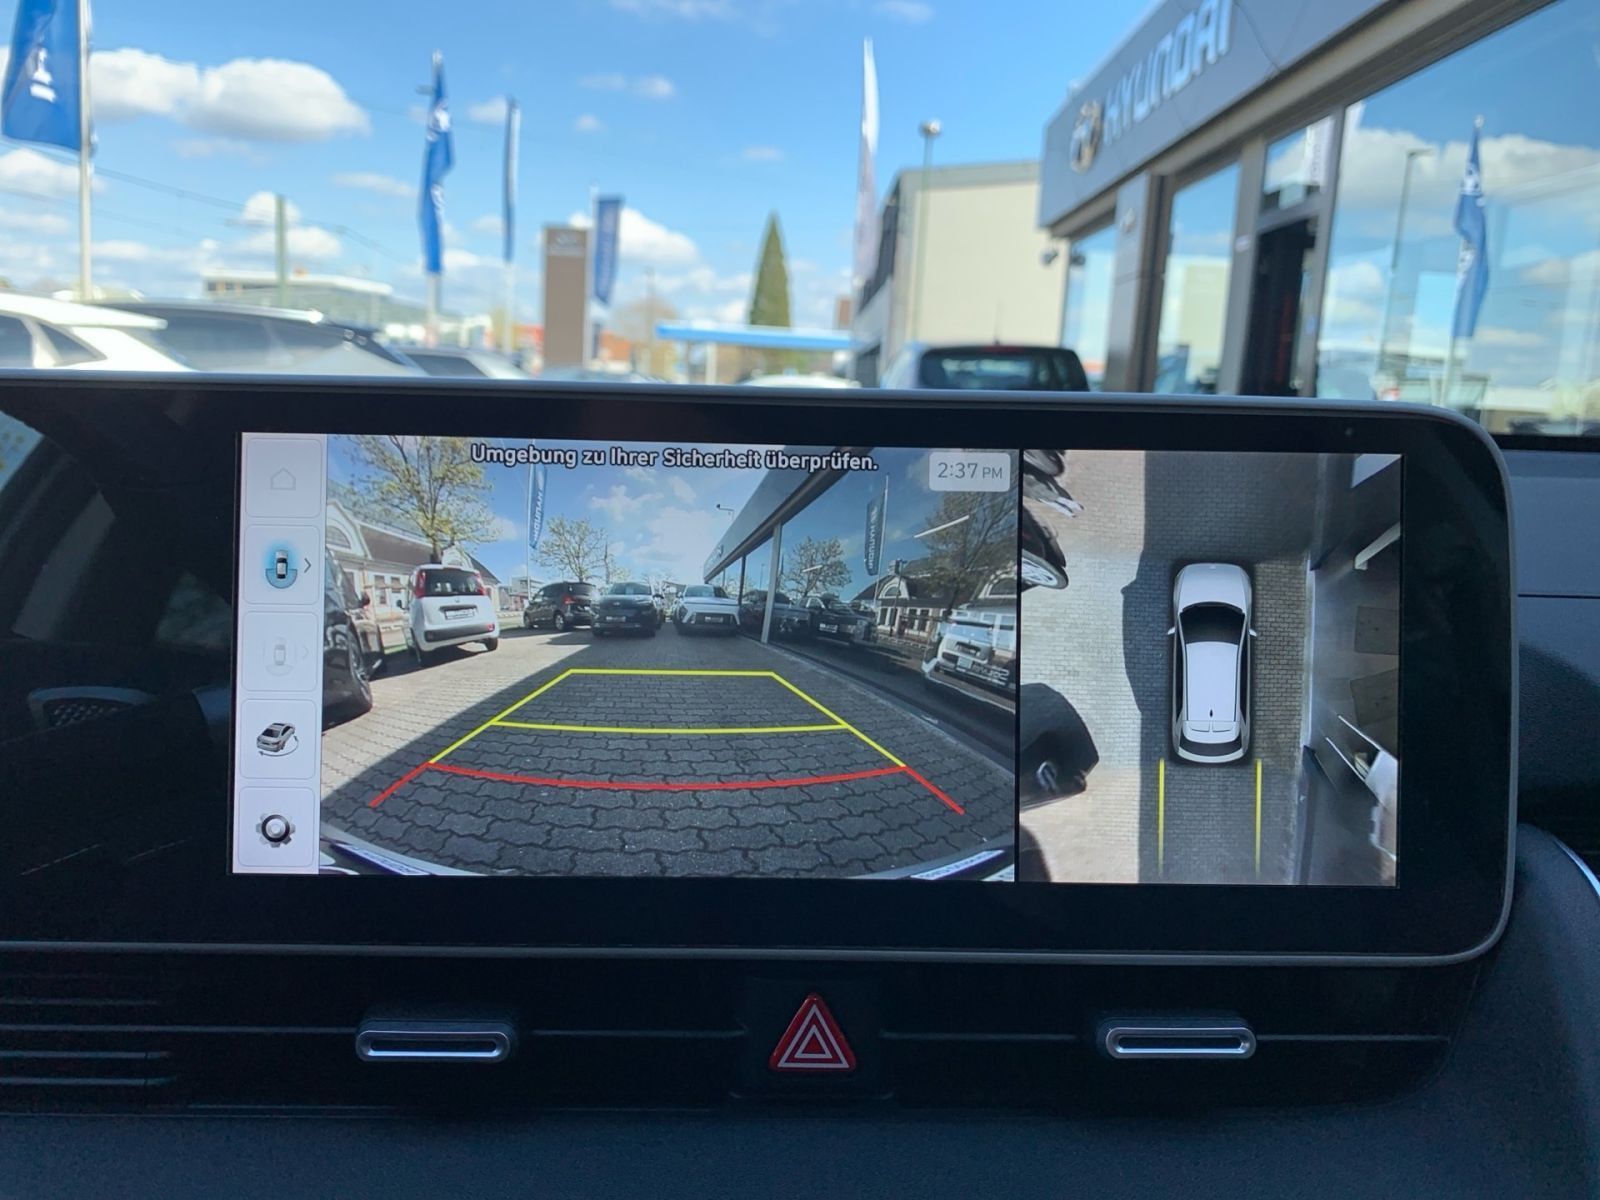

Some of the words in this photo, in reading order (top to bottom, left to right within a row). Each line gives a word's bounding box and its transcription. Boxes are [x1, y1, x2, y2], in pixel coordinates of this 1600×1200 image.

[1103, 0, 1231, 146] HYUNDAI
[471, 444, 576, 467] Umgebung
[582, 450, 605, 465] zu
[610, 447, 658, 466] Ihrer
[663, 449, 761, 468] Sicherheit
[766, 451, 878, 472] überprüfen.
[937, 462, 978, 479] 2:37
[982, 467, 1003, 479] PM
